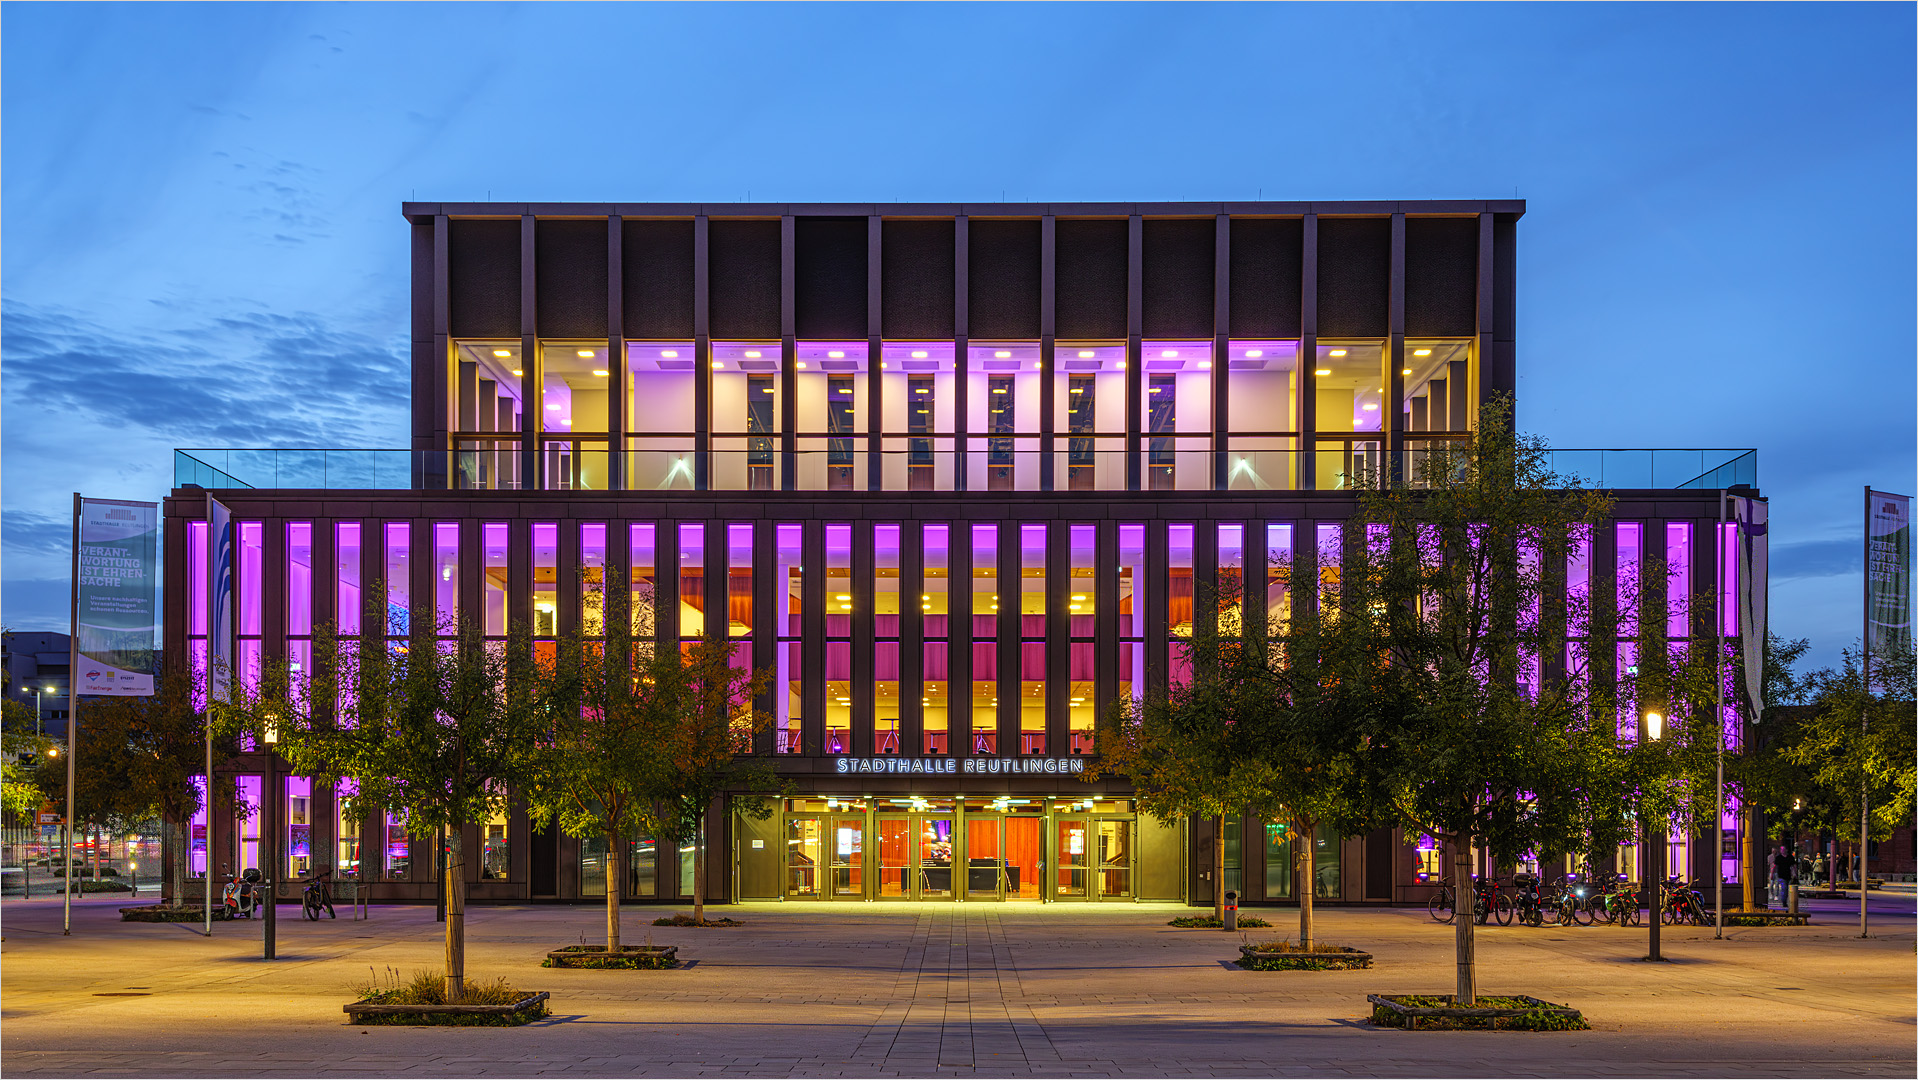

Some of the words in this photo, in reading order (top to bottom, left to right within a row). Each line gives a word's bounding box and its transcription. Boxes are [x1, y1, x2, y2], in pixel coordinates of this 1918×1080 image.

[82, 546, 131, 557] VERANT-
[82, 556, 140, 568] WORTUNG
[81, 566, 99, 576] IST
[103, 567, 147, 579] EHREN-
[80, 576, 121, 587] SACHE
[837, 758, 956, 773] STADTHALLE
[964, 759, 1084, 773] REUTLINGEN
